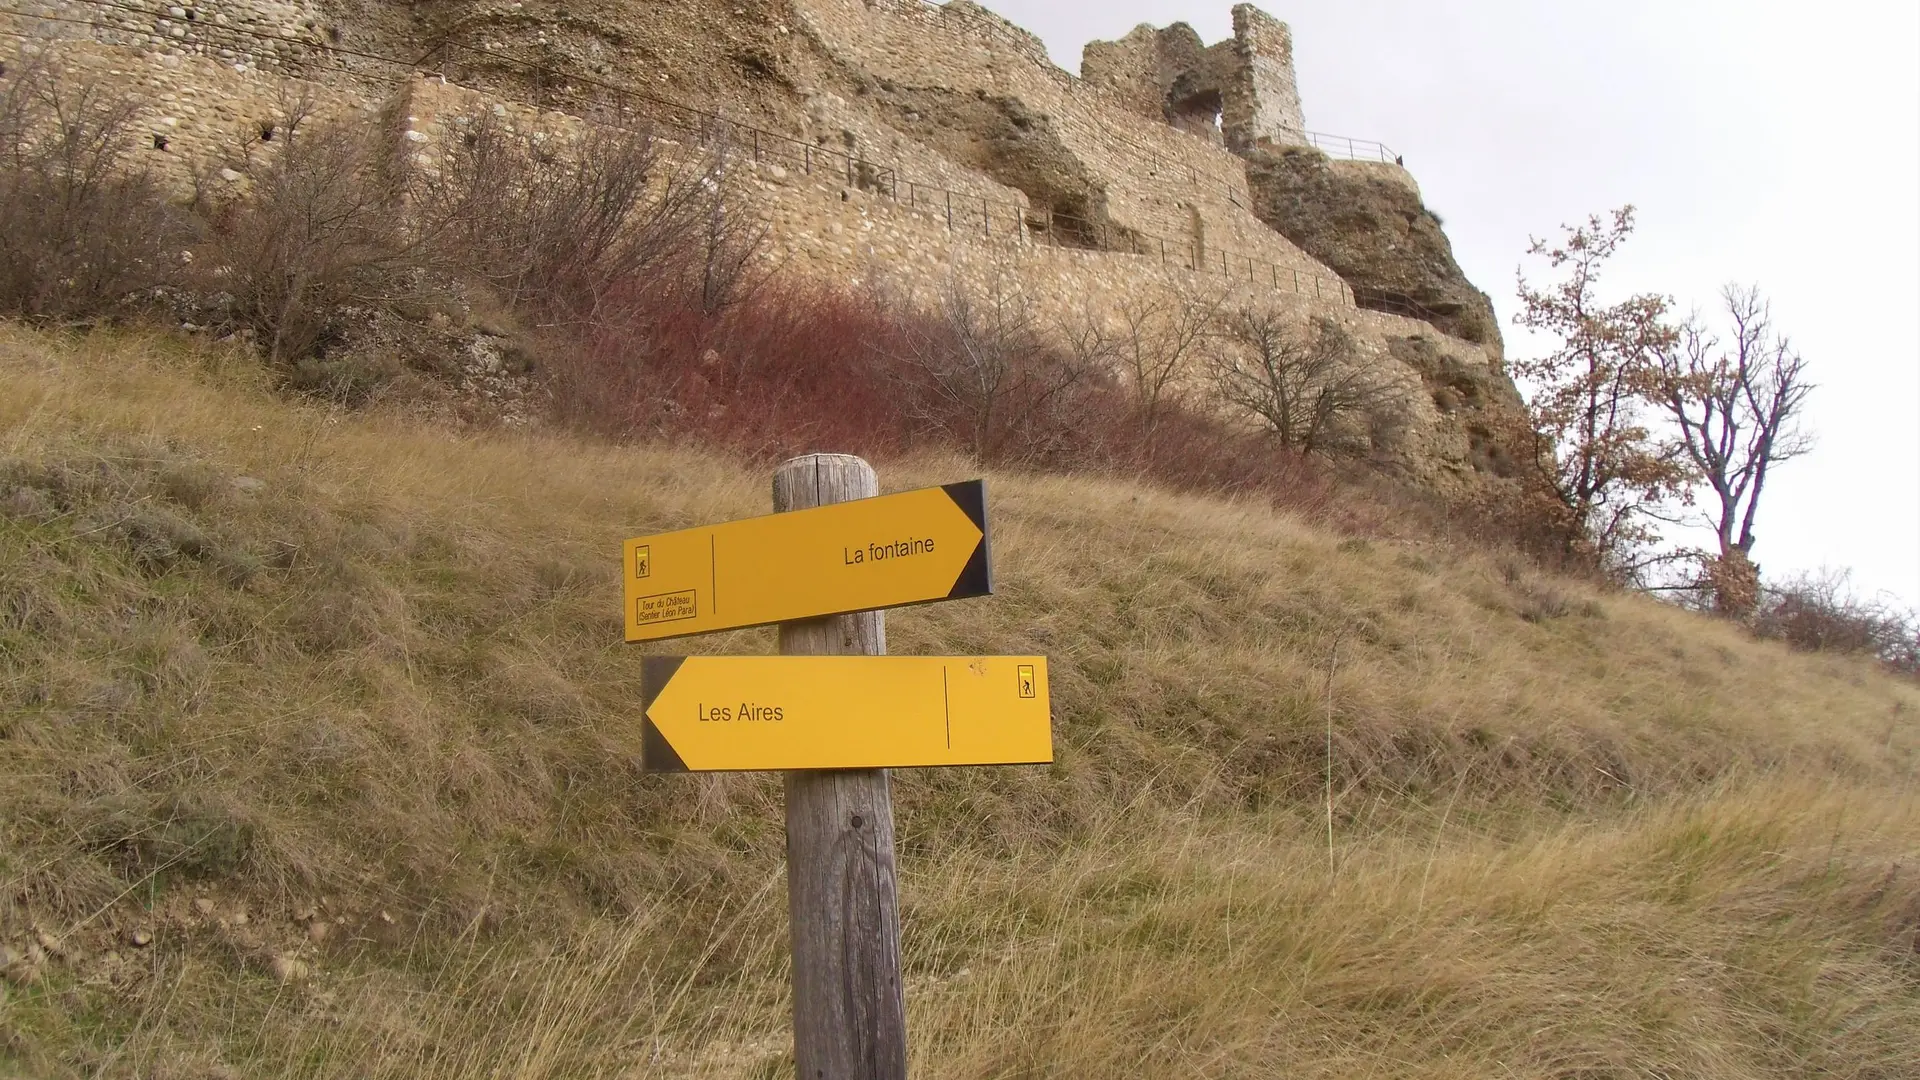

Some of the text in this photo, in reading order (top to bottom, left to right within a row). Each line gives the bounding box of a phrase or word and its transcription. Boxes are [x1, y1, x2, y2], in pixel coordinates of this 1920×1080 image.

[844, 537, 935, 565] La fontaine
[642, 600, 655, 610] Tour
[656, 599, 665, 608] du
[699, 702, 784, 722] Les Aires
